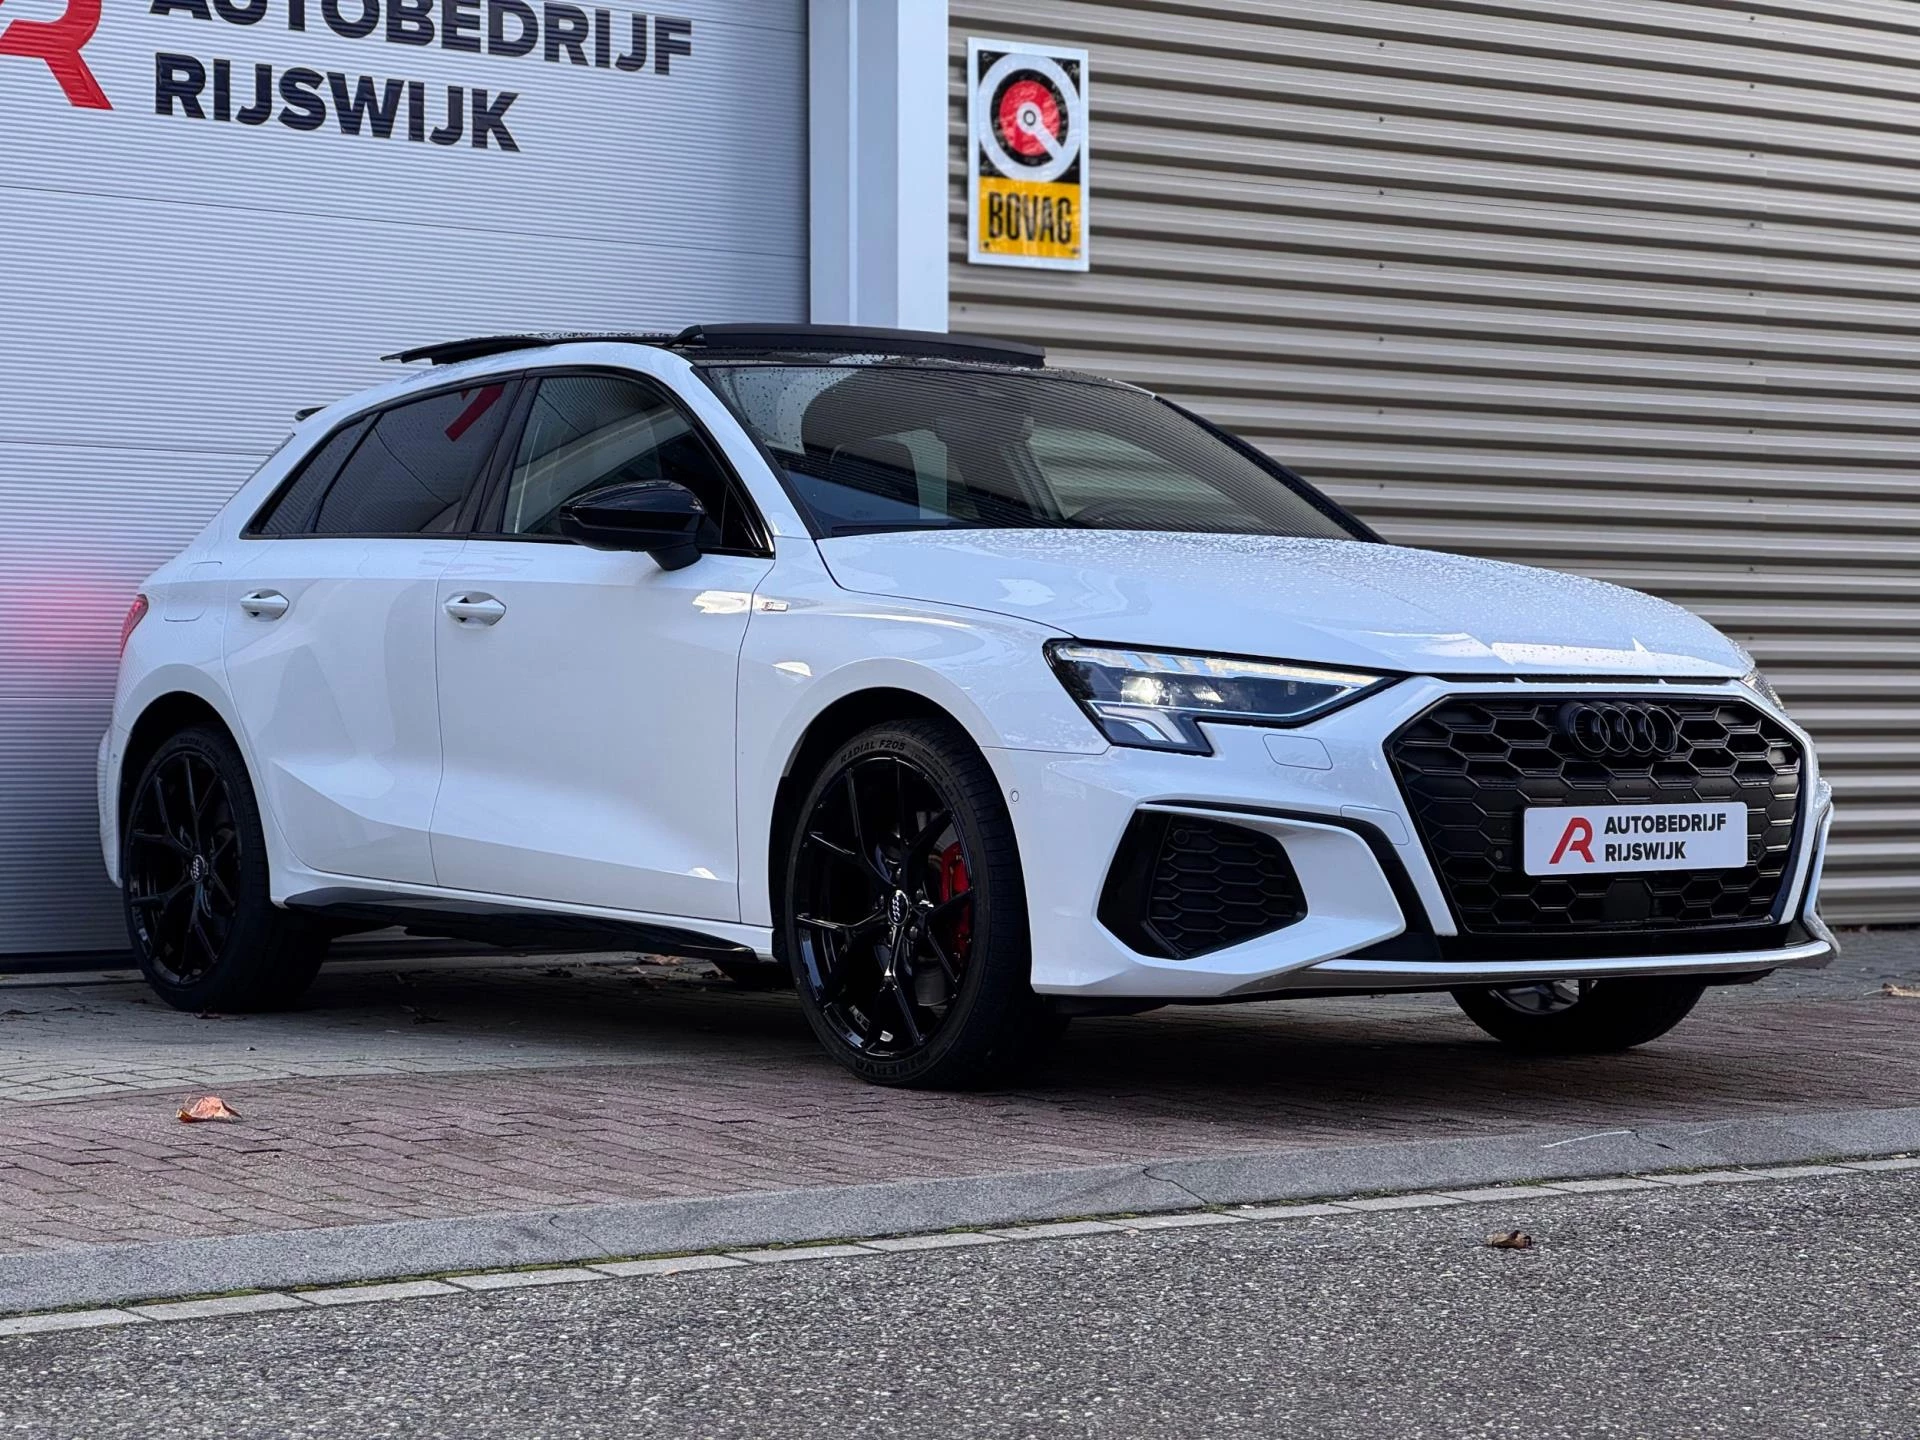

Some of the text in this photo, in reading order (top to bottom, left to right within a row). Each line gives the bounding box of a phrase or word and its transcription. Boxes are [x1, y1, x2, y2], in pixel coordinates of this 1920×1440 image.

[150, 0, 692, 76] OBEDRIJF
[154, 52, 520, 152] RIJSWIJK
[988, 191, 1072, 244] BOVAG
[841, 739, 906, 763] RADIAL F205
[1604, 813, 1726, 835] AUTOBEDRIJF
[1605, 841, 1686, 862] RIJSWIJK
